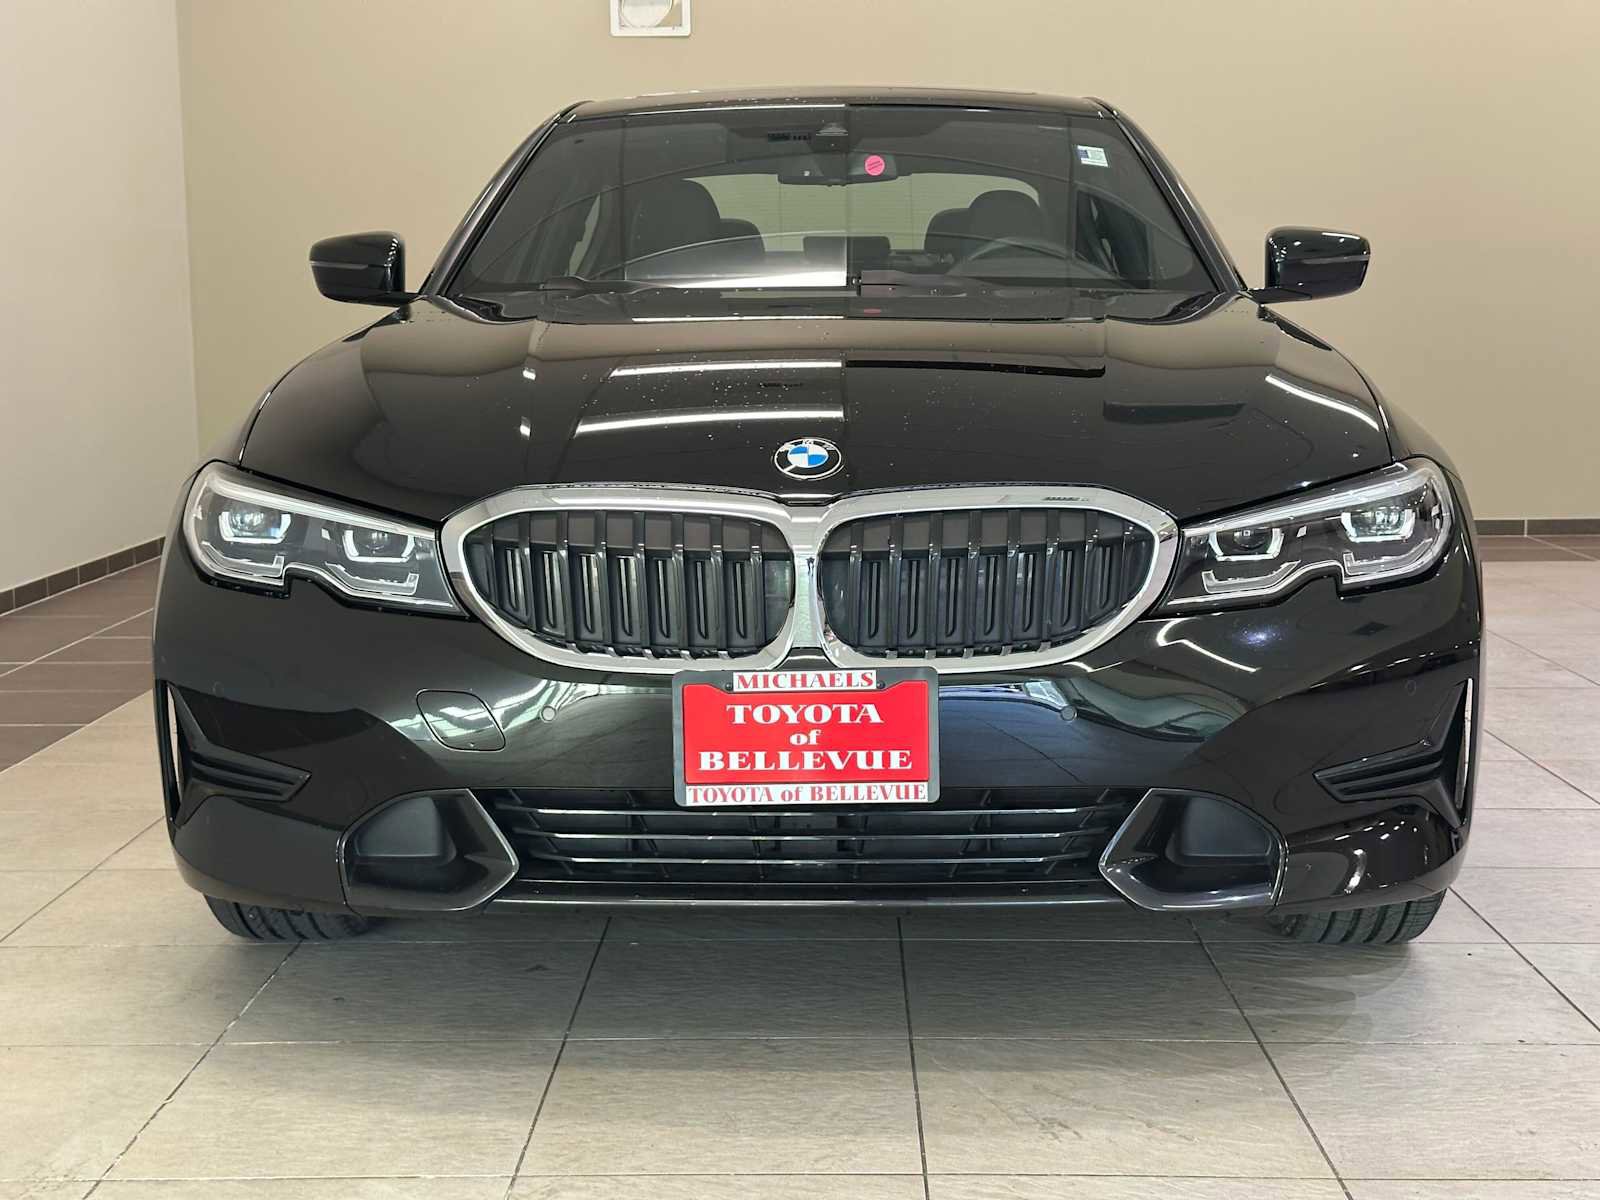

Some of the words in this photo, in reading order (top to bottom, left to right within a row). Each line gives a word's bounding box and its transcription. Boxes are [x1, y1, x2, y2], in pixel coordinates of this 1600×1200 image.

[737, 672, 873, 689] MICHAELS
[726, 704, 883, 724] TOYOTA
[789, 729, 822, 745] of
[698, 751, 912, 771] BELLEVUE
[688, 786, 773, 803] TOYOTA
[781, 787, 803, 801] of
[810, 783, 926, 801] BELLEVUE
